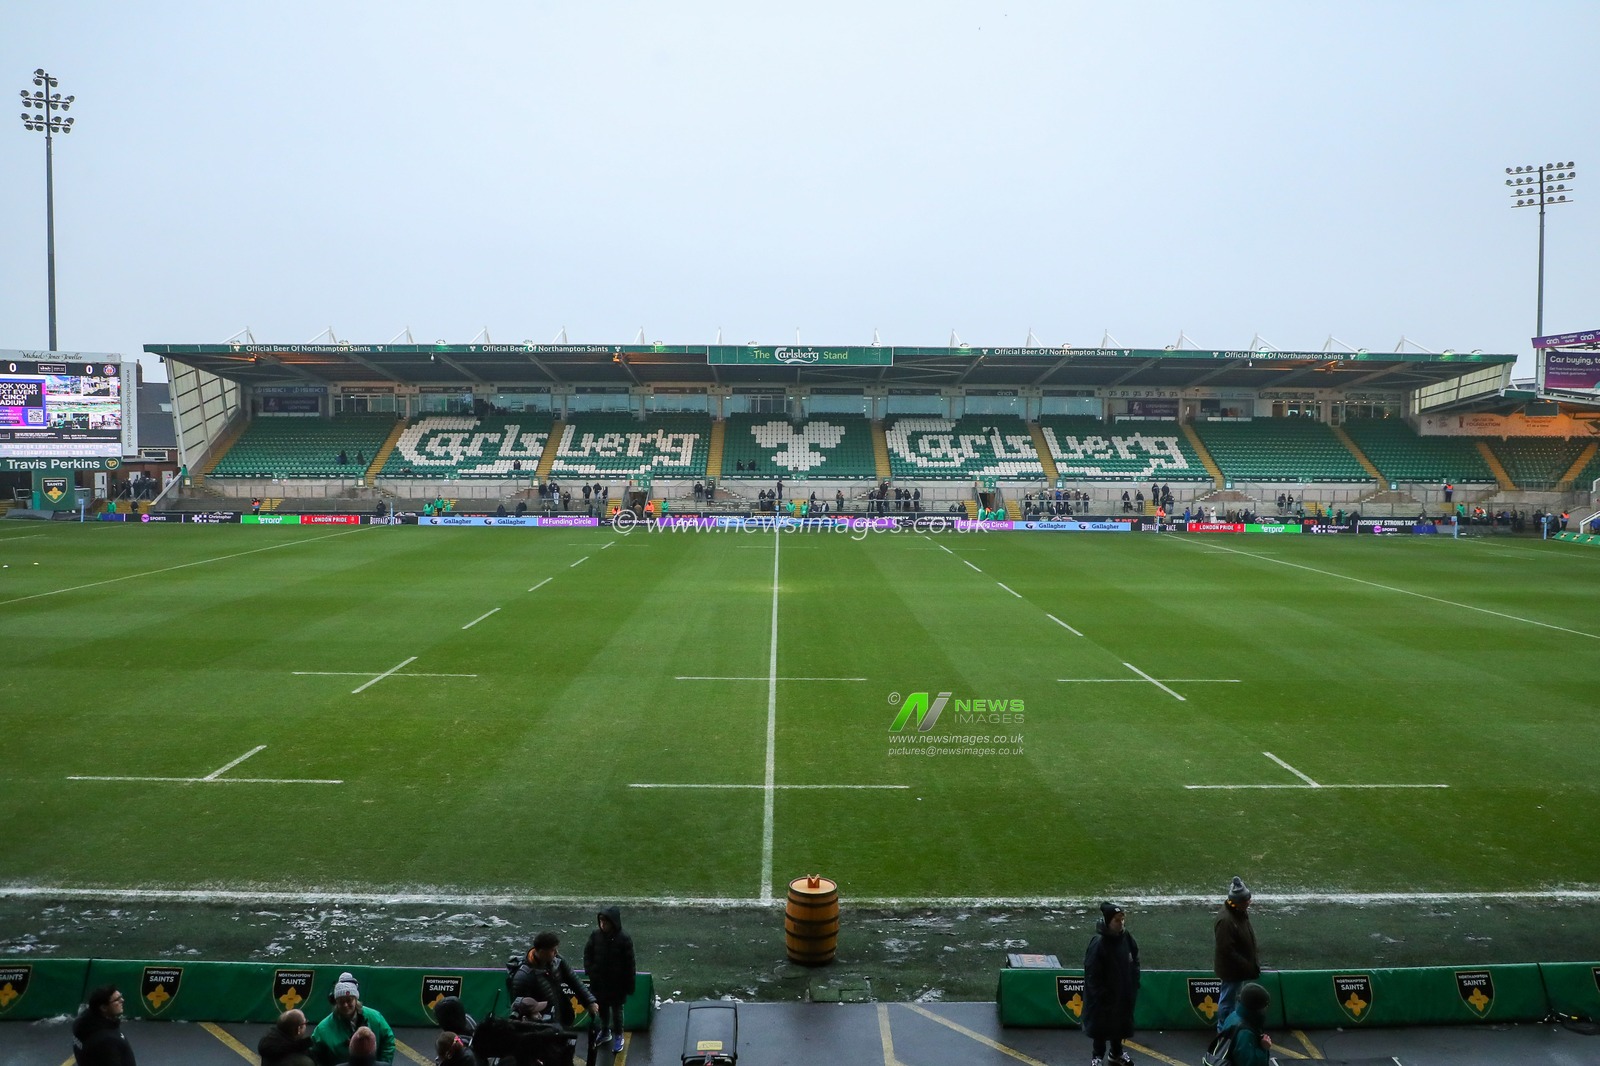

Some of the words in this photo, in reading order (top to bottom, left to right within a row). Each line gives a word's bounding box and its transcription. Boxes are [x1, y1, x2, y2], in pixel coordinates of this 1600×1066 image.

[301, 345, 348, 353] Northampton
[538, 345, 585, 353] Northampton
[587, 345, 608, 353] Saints
[754, 350, 770, 359] The
[774, 347, 819, 361] Carlsberg
[823, 351, 848, 359] Stand
[1277, 352, 1322, 360] Northampton
[1566, 356, 1593, 365] buying,
[9, 363, 17, 372] 0
[86, 365, 93, 374] 0
[6, 459, 47, 469] Travis
[51, 459, 100, 469] Perkins
[370, 516, 388, 525] BUFFALO
[149, 975, 175, 984] SAINTS
[281, 978, 306, 986] SAINTS
[1463, 979, 1487, 987] SAINTS
[429, 984, 455, 993] SAINTS
[1195, 986, 1220, 994] SAINTS
[1340, 983, 1365, 991] SAINTS
